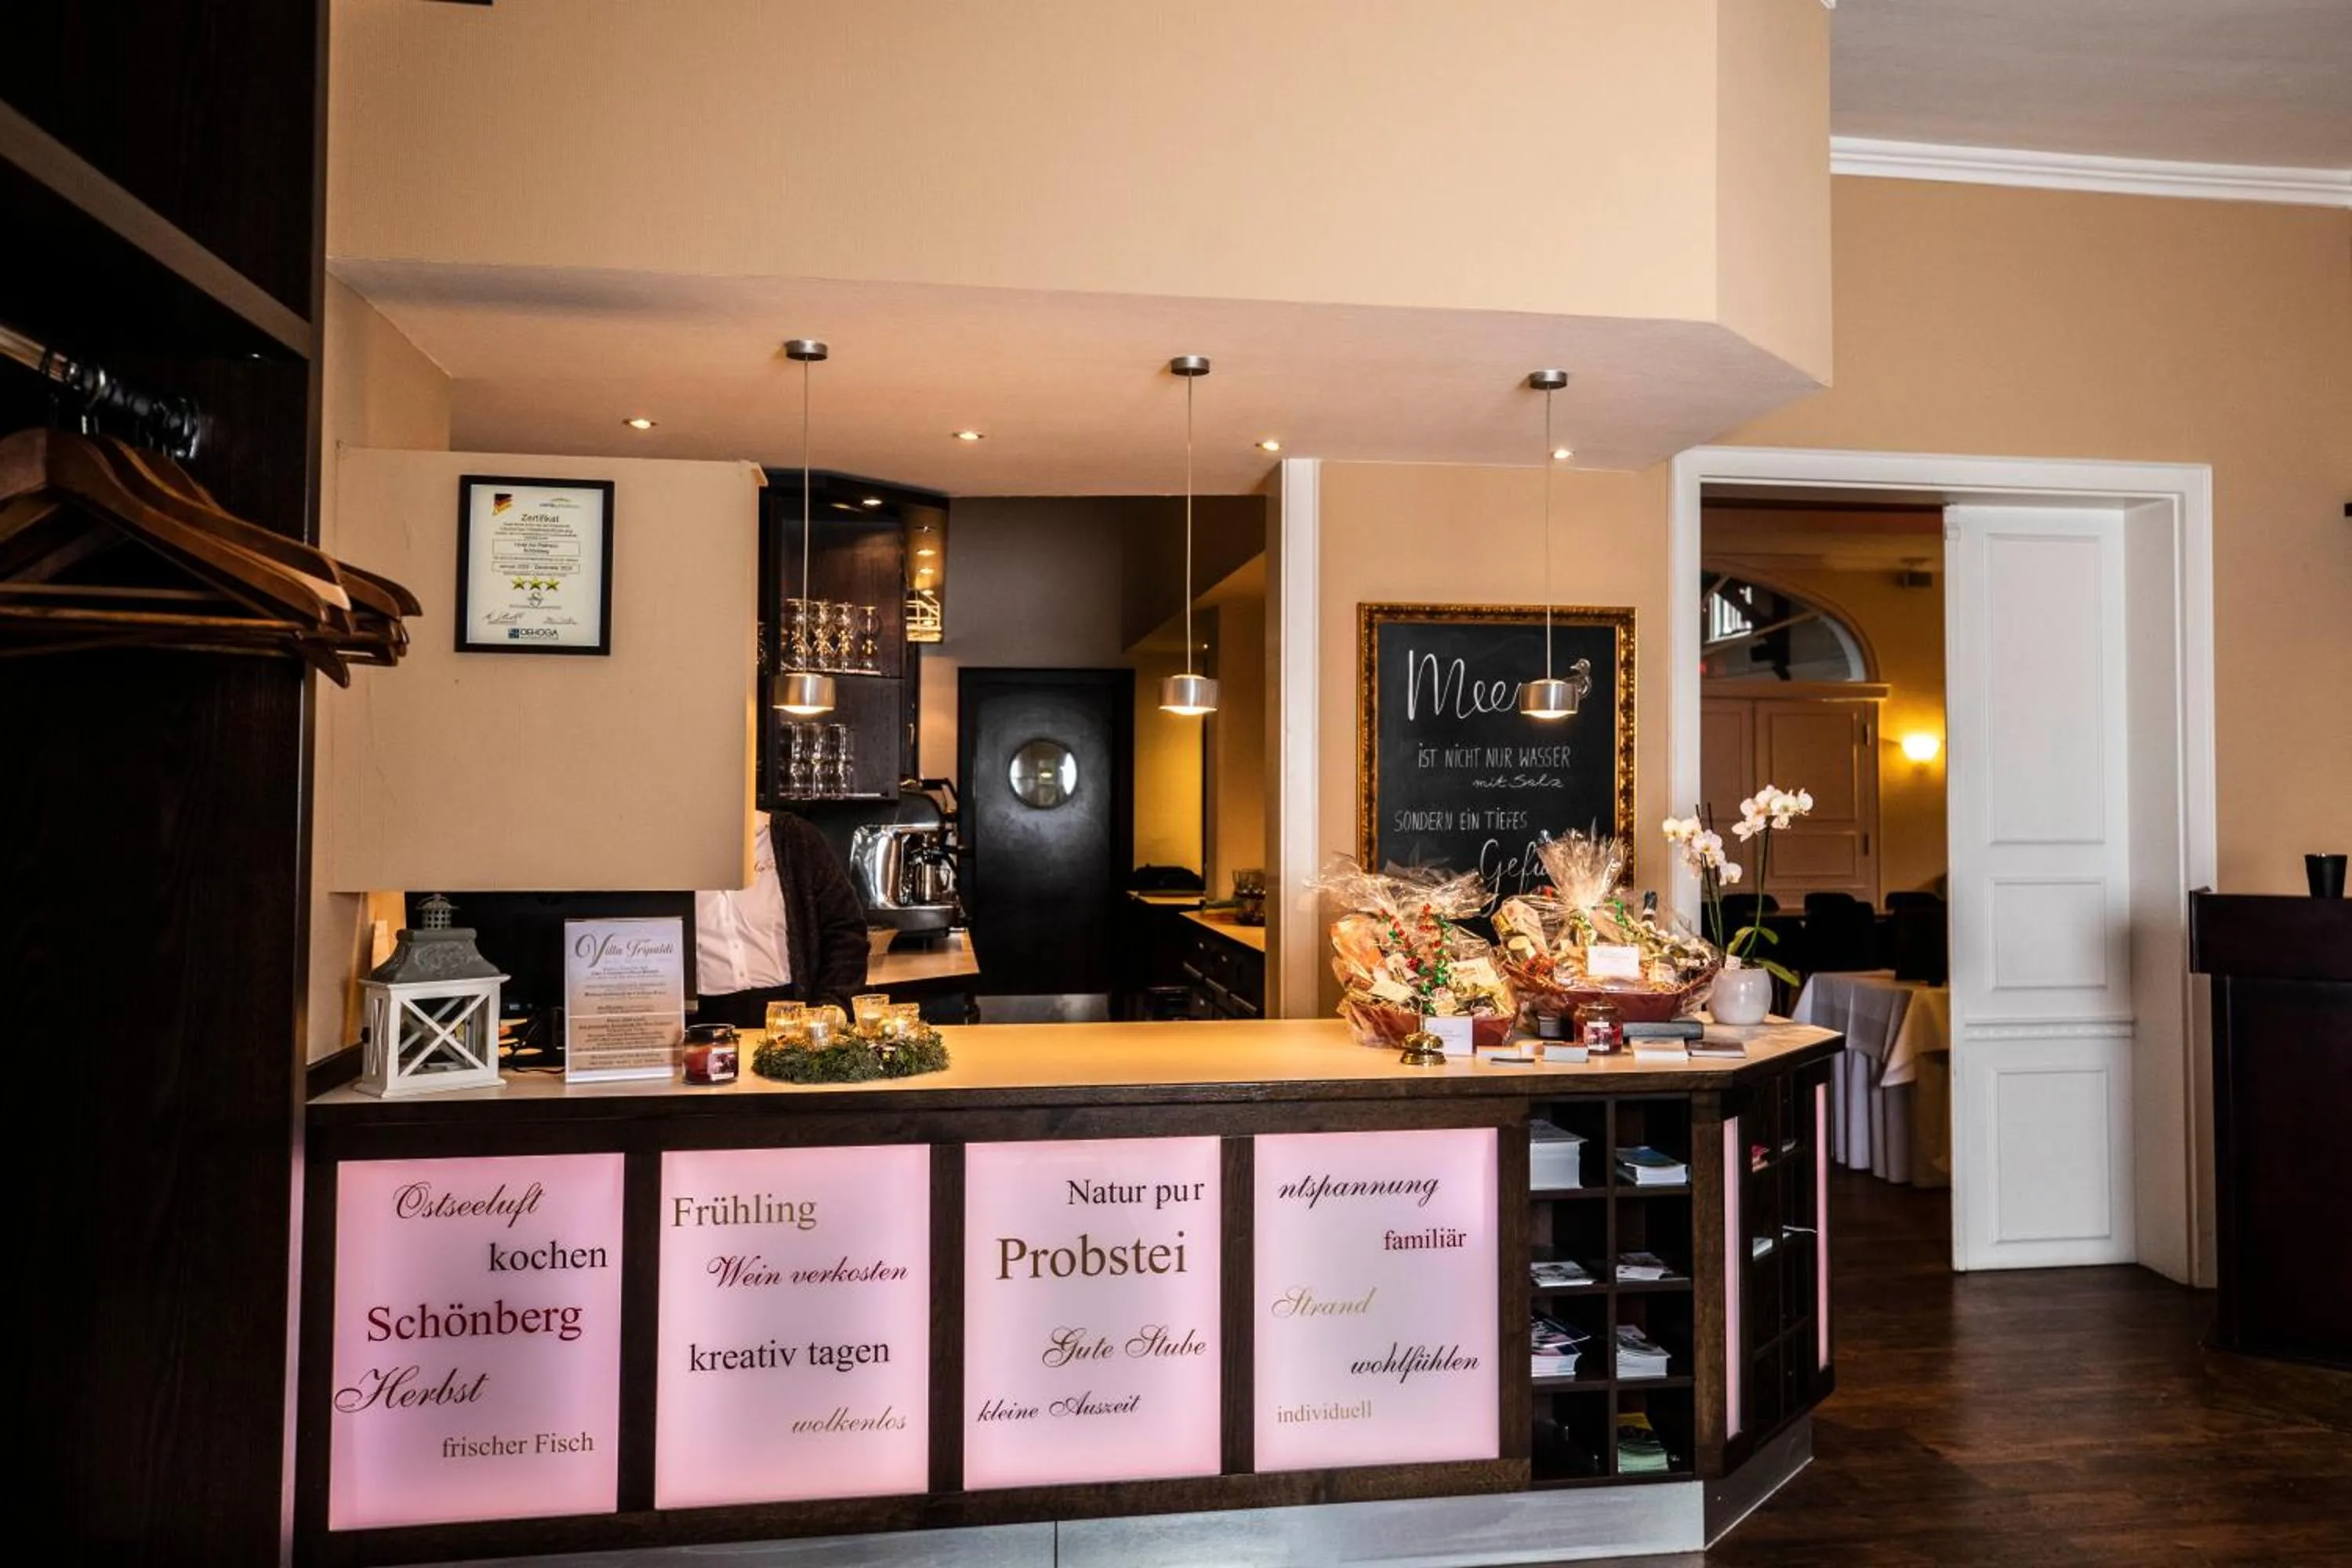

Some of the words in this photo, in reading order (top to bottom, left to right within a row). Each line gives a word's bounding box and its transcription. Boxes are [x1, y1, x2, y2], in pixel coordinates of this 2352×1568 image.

[1407, 649, 1523, 720] Mee
[1486, 746, 1513, 768] NUR
[1518, 746, 1571, 769] WASSER
[1472, 775, 1507, 788] mit
[1394, 810, 1454, 832] SONDERN
[392, 1180, 546, 1229] Ostseeluft
[1065, 1178, 1147, 1206] Natur
[1154, 1181, 1205, 1210] pur
[1277, 1174, 1440, 1210] ntspannung
[671, 1192, 818, 1230] Frühling
[488, 1240, 609, 1272] kochen
[995, 1229, 1189, 1281] Probstei
[1382, 1226, 1468, 1252] familiär
[706, 1254, 783, 1288] Wein
[789, 1256, 909, 1285] verkosten
[1271, 1286, 1377, 1319] Strand
[367, 1298, 584, 1343] Schönberg
[688, 1338, 798, 1374] kreativ
[807, 1340, 891, 1374] tagen
[1041, 1327, 1116, 1368] Gute
[1124, 1323, 1208, 1359] Stube
[1350, 1341, 1480, 1385] wohlfühlen
[334, 1365, 491, 1414] Herbst
[791, 1404, 907, 1435] wolkenlos
[976, 1398, 1040, 1424] kleine
[1048, 1390, 1142, 1417] Auszeit
[1277, 1399, 1372, 1425] individuell
[442, 1435, 528, 1458] frischer
[535, 1431, 595, 1455] Fisch
